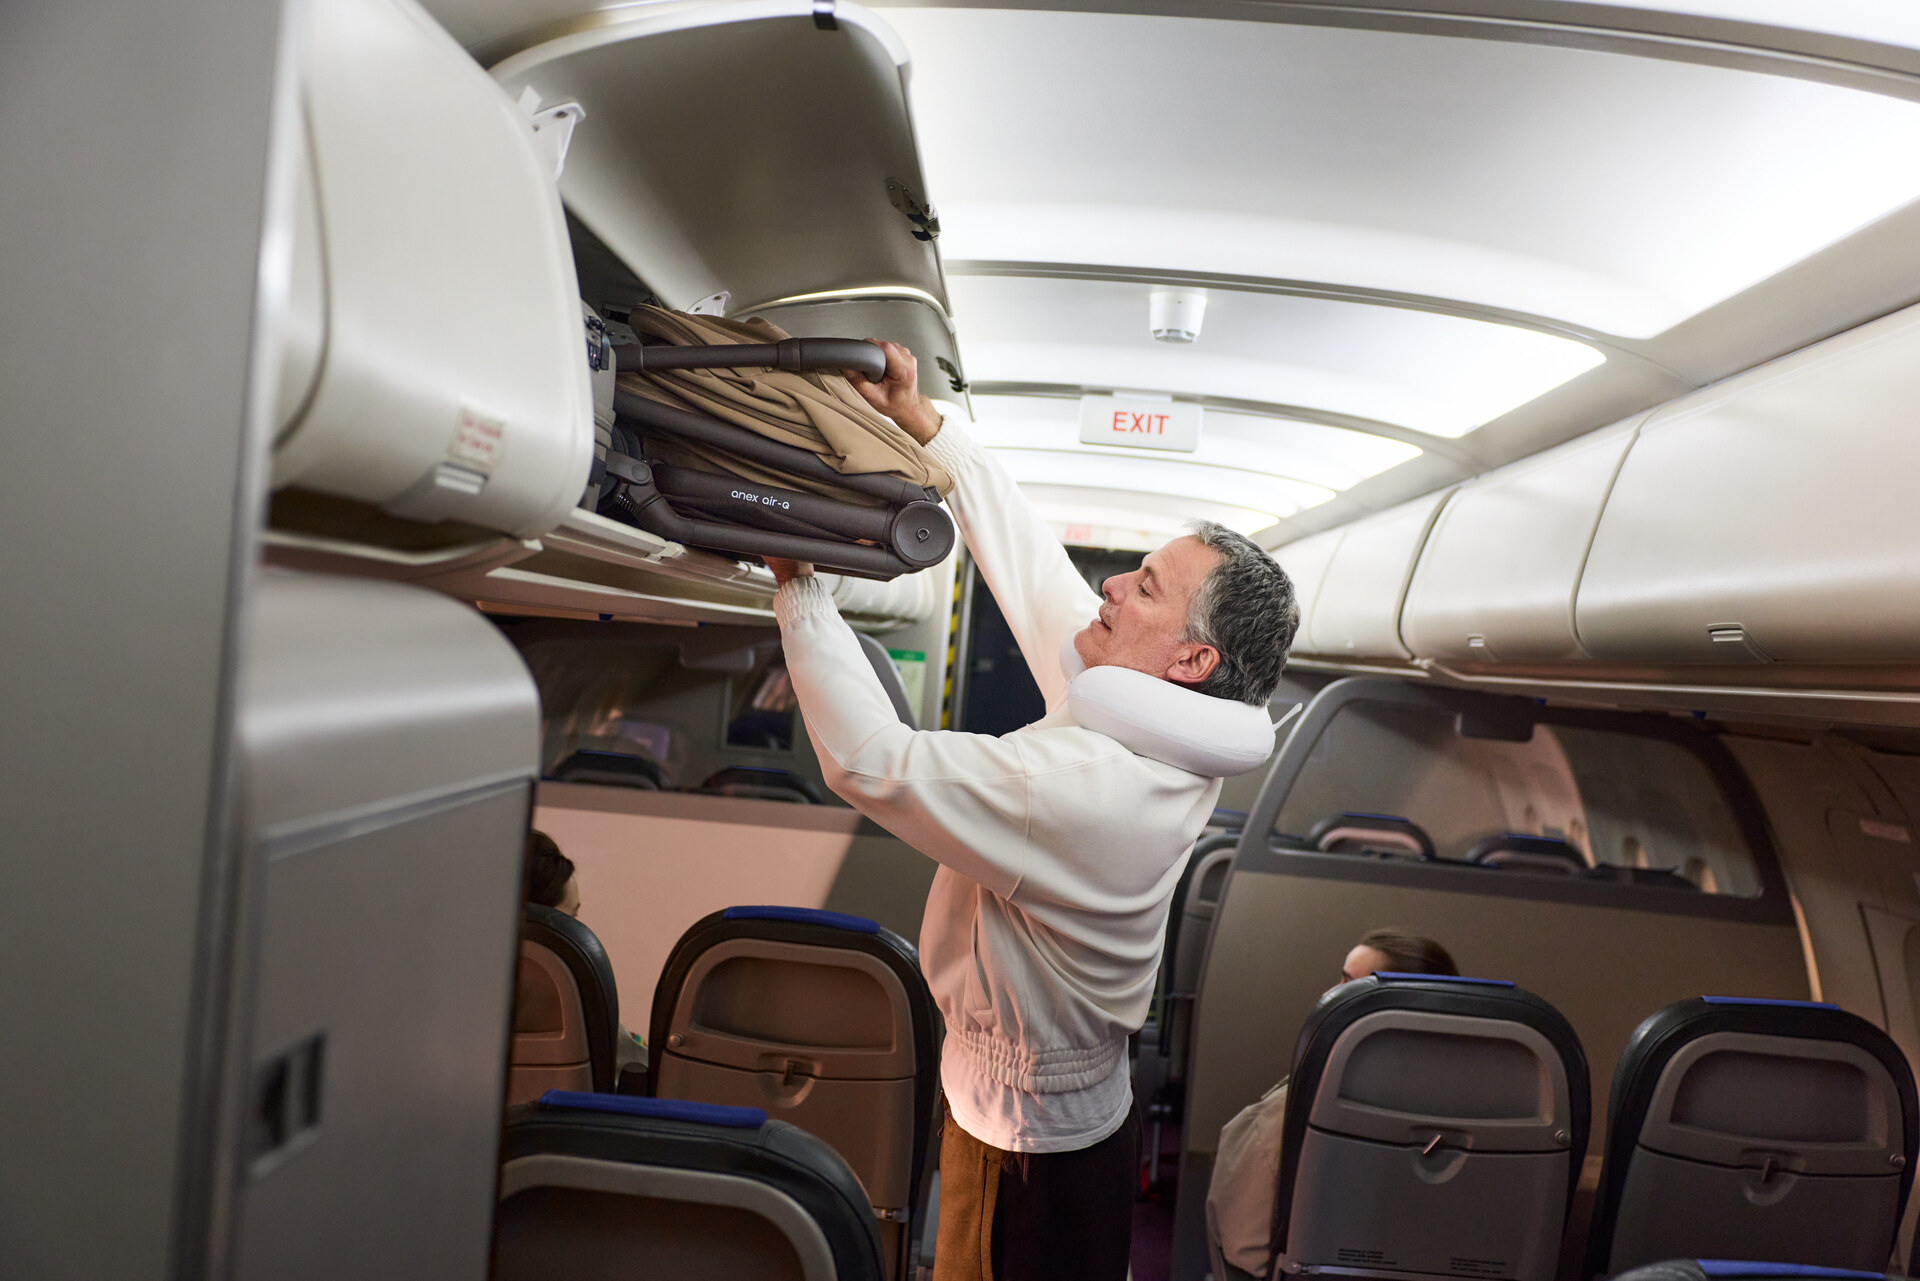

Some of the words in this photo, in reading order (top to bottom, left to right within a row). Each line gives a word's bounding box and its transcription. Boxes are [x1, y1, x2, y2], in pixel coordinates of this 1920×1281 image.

[1112, 410, 1170, 435] EXIT
[731, 490, 759, 503] anex
[762, 496, 790, 510] air-Q
